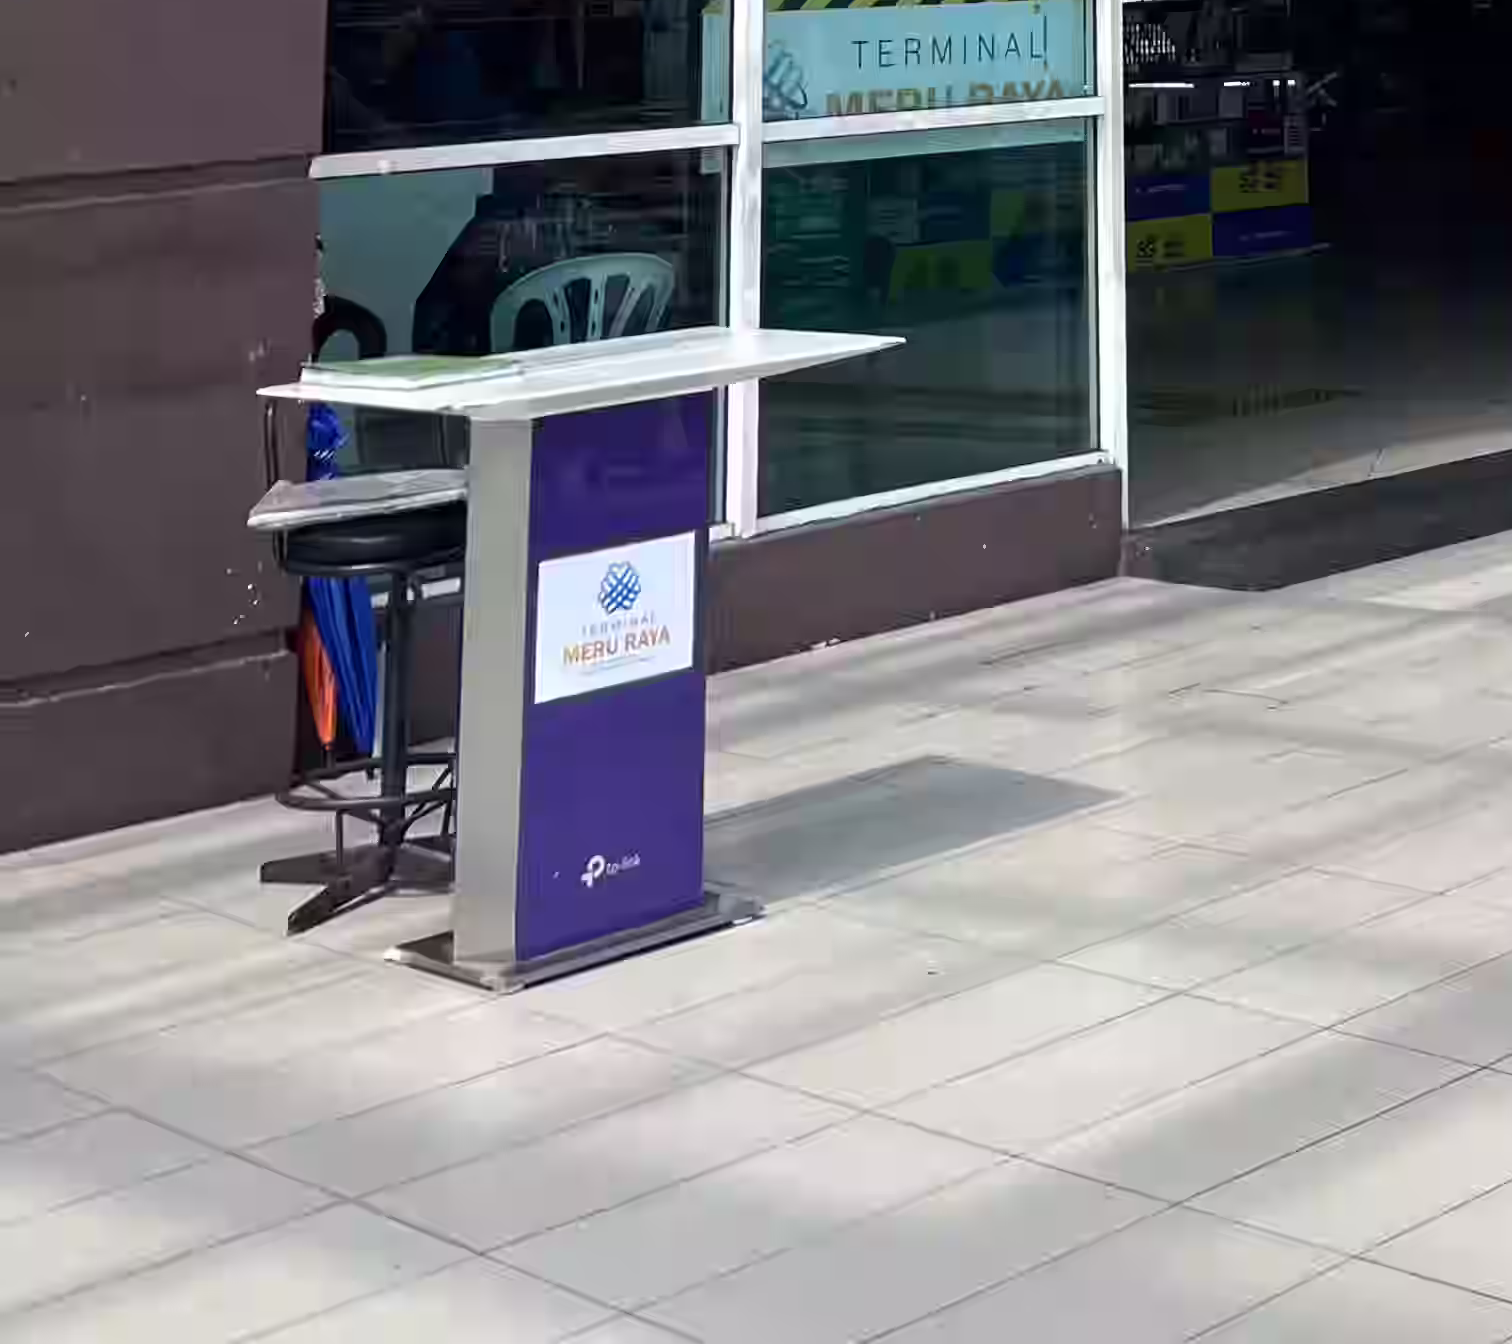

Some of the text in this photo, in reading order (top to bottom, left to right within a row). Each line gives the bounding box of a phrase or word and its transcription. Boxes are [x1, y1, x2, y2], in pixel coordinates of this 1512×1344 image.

[851, 28, 1043, 70] TERMINAL
[563, 625, 671, 665] MERU RAYA
